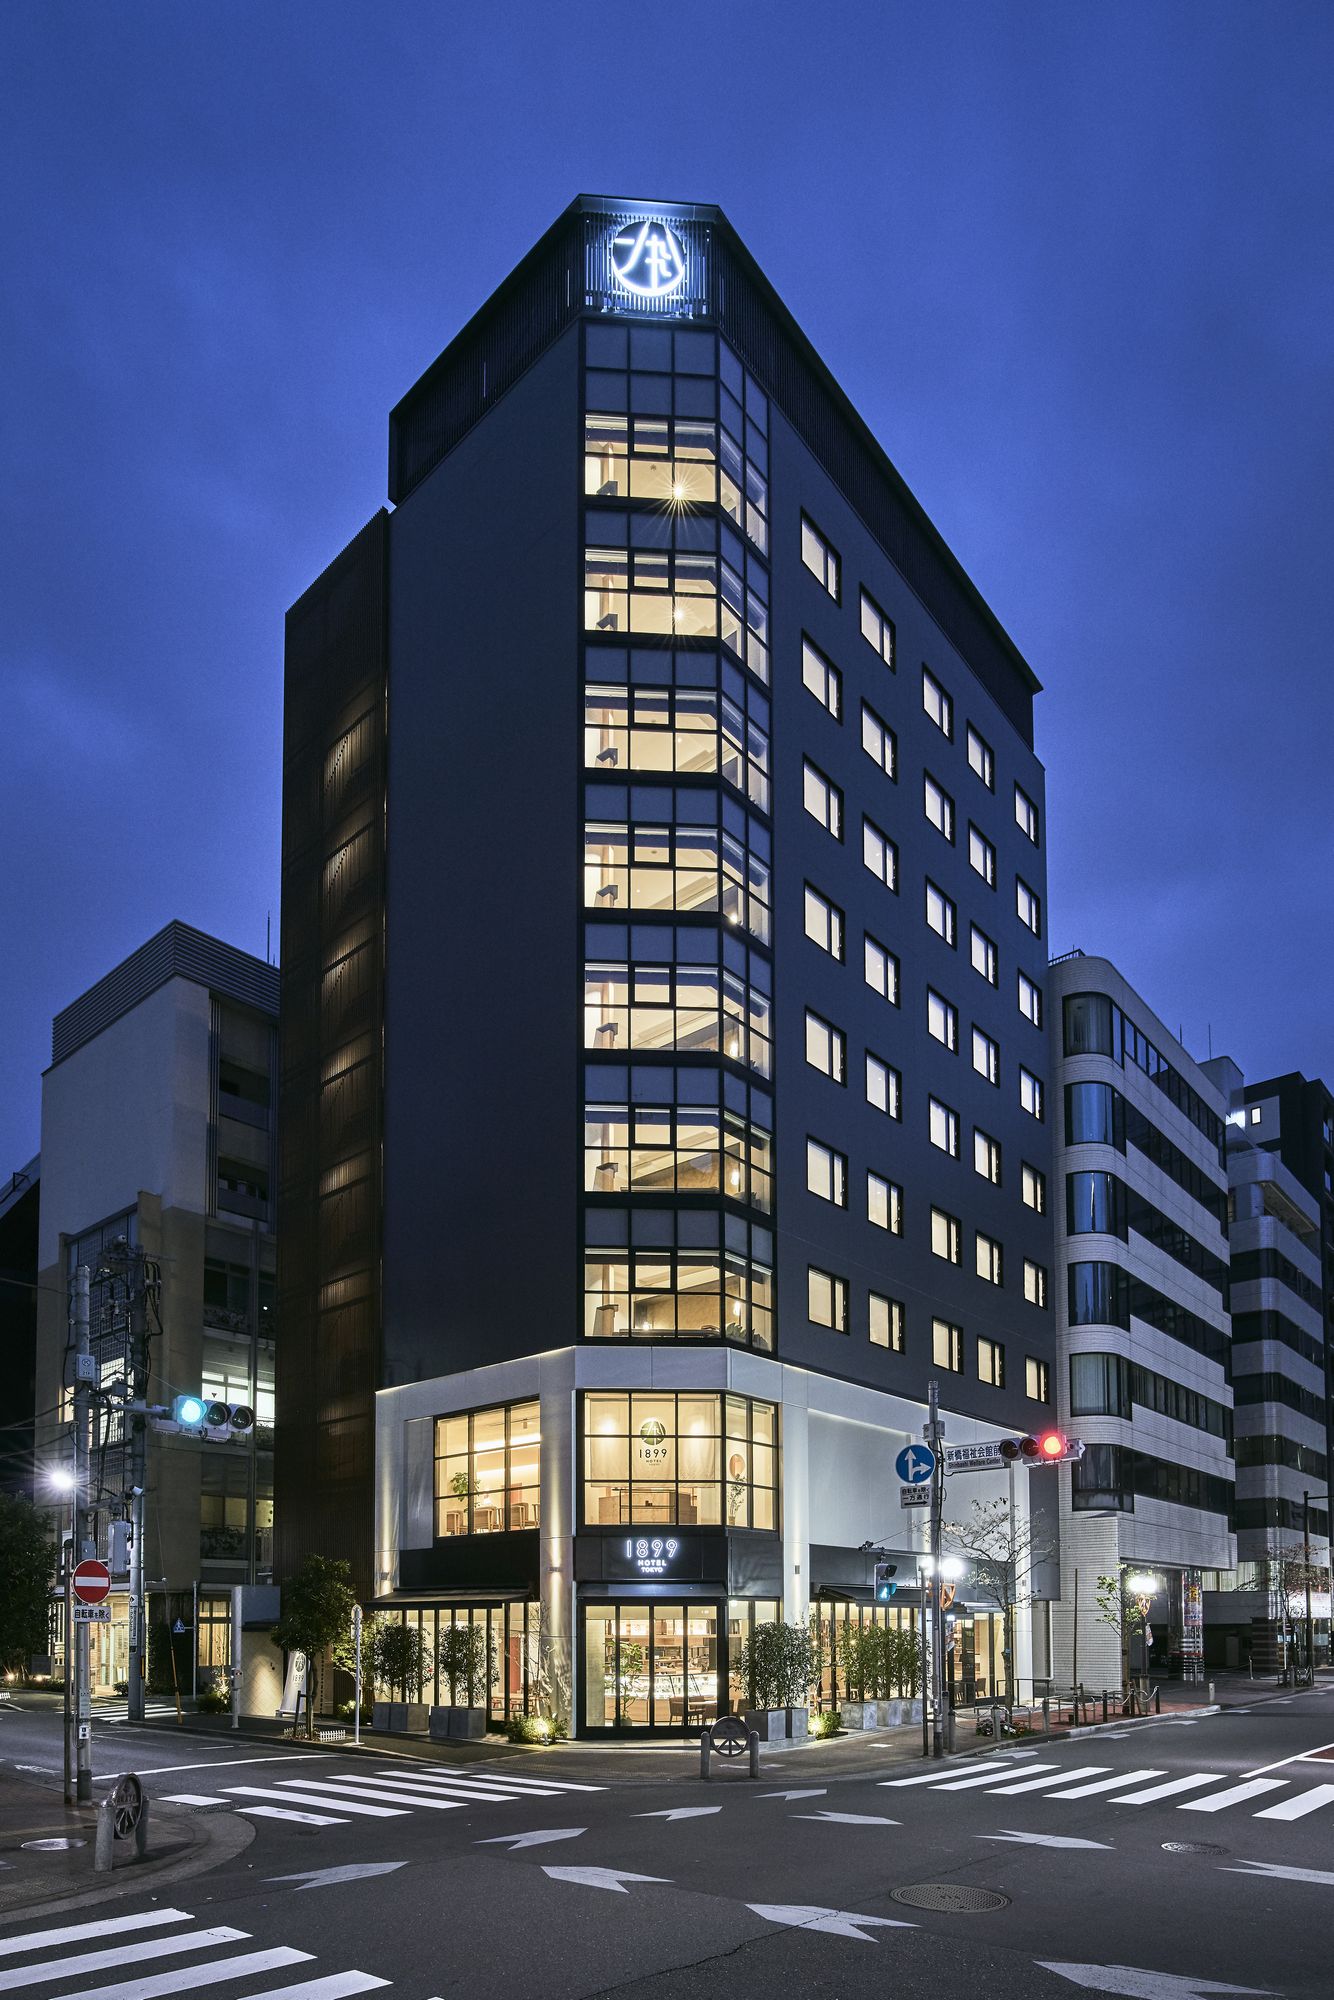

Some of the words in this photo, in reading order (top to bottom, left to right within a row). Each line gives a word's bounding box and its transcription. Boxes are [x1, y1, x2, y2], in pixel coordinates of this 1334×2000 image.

[639, 1448, 667, 1458] 1899
[626, 1539, 678, 1558] 1899
[637, 1559, 667, 1567] HOTEL
[74, 1609, 110, 1619] 自転車を除く
